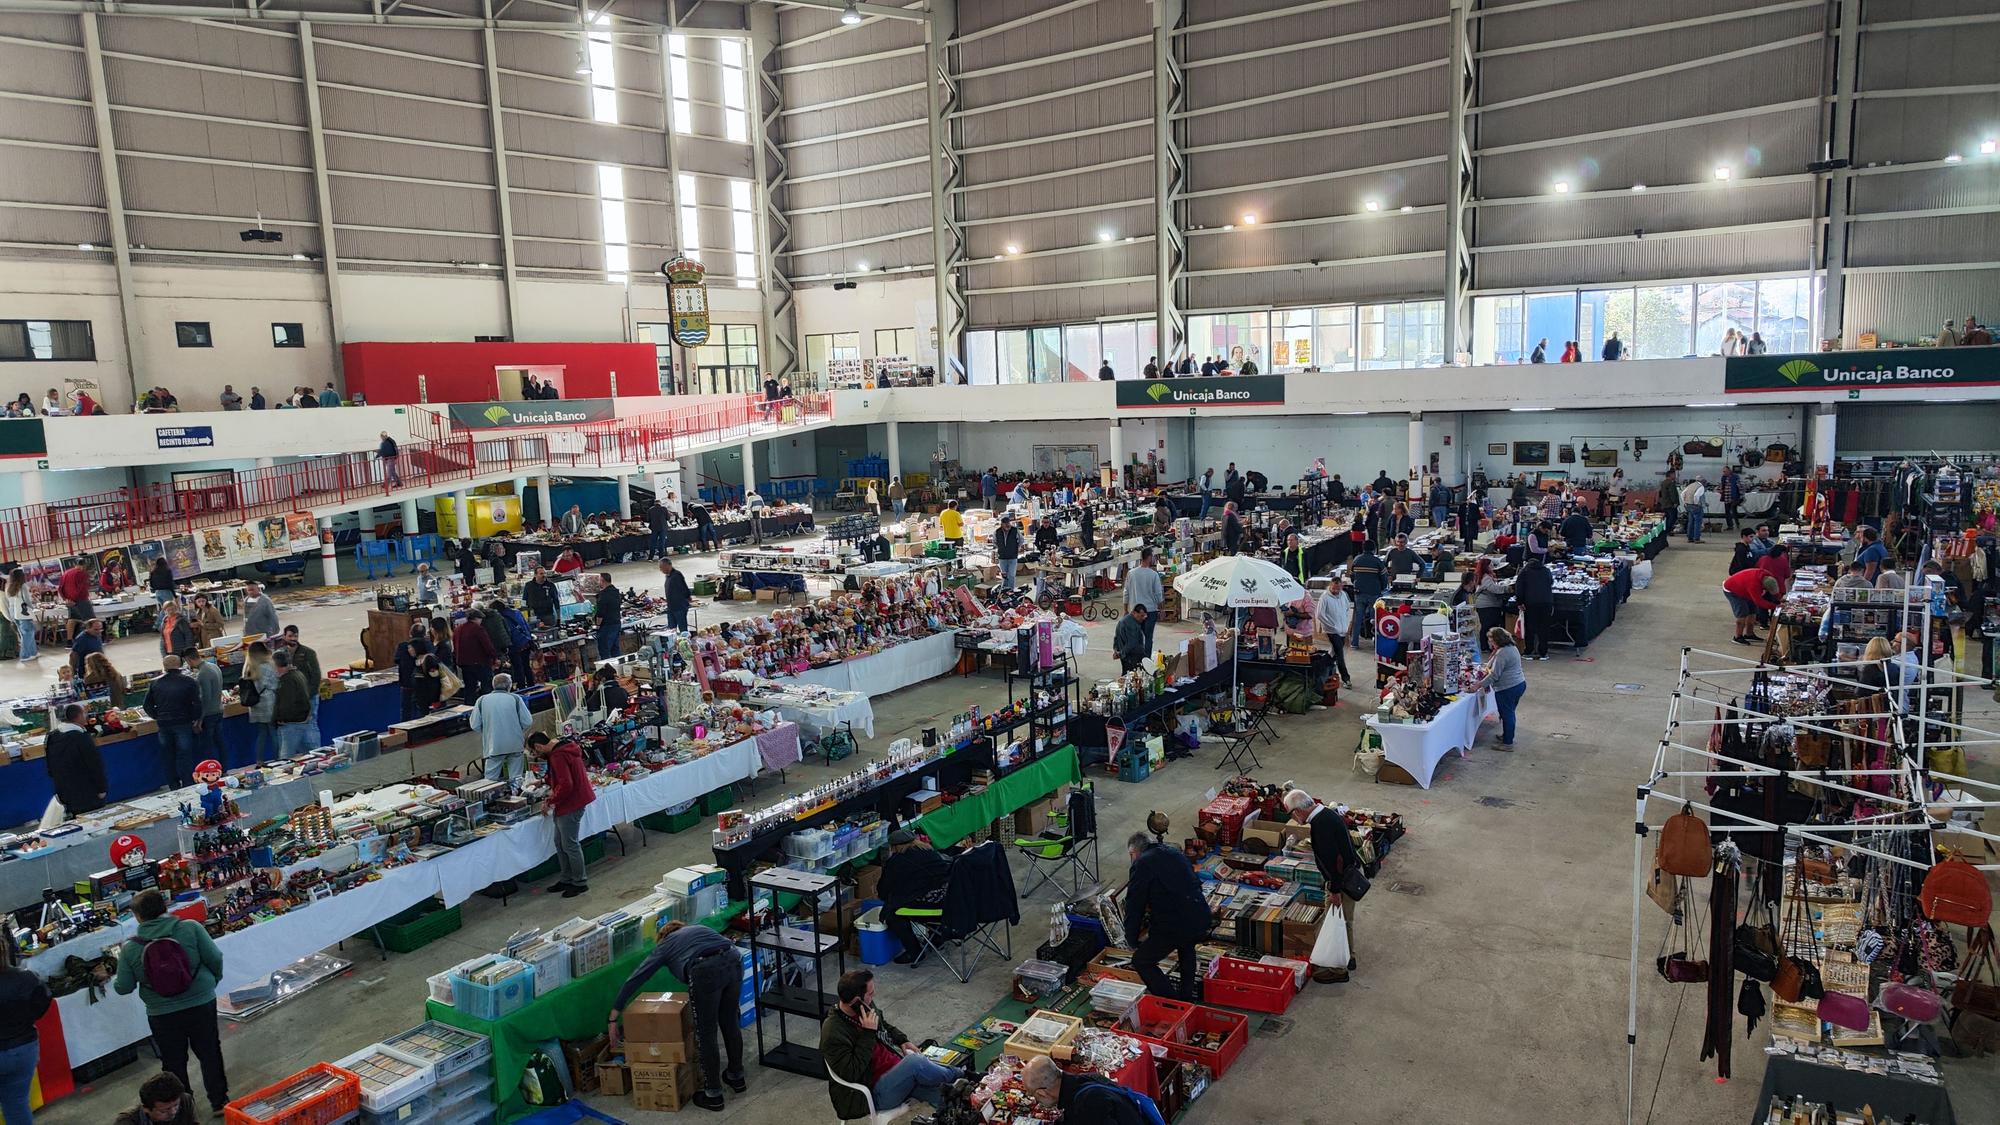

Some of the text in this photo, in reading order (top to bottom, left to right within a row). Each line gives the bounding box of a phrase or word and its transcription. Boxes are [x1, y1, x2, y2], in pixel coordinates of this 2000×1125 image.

[1823, 365, 1955, 383] Unicaja Banco
[1173, 388, 1250, 403] Unicaja Banco
[513, 410, 587, 425] Unicaja Banco
[159, 437, 199, 446] RECINTO FERIAL
